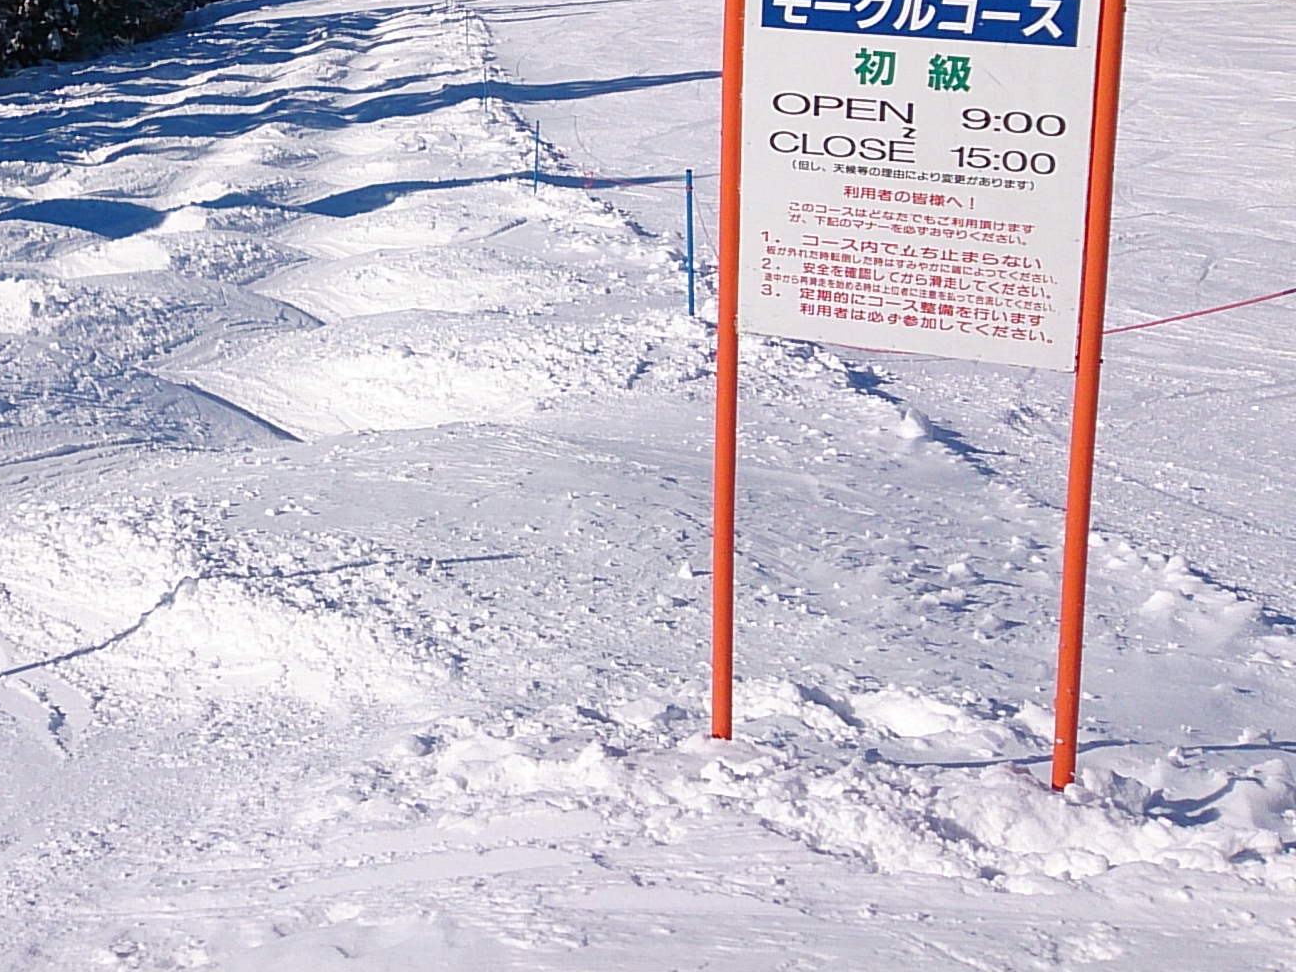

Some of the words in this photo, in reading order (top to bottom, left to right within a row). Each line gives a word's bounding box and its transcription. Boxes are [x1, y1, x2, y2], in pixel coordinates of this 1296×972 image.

[772, 92, 914, 124] OPEN
[961, 108, 1066, 137] 9:00
[769, 130, 915, 163] CLOSE
[950, 146, 1056, 175] 15:00
[843, 185, 974, 210] 利用者の皆様へ！
[789, 202, 1035, 234] このコースはどなたでもご利用頂けます
[789, 211, 1027, 245] が、下記のマナーを必ずお守りください。
[802, 234, 1041, 269] コース内で立ち止まらない
[803, 262, 1051, 299] 安全を確認してから滑走してください。
[799, 287, 1045, 326] 定期的にコース整備を行います
[799, 302, 1053, 343] 利用者は必ず参加してください。
